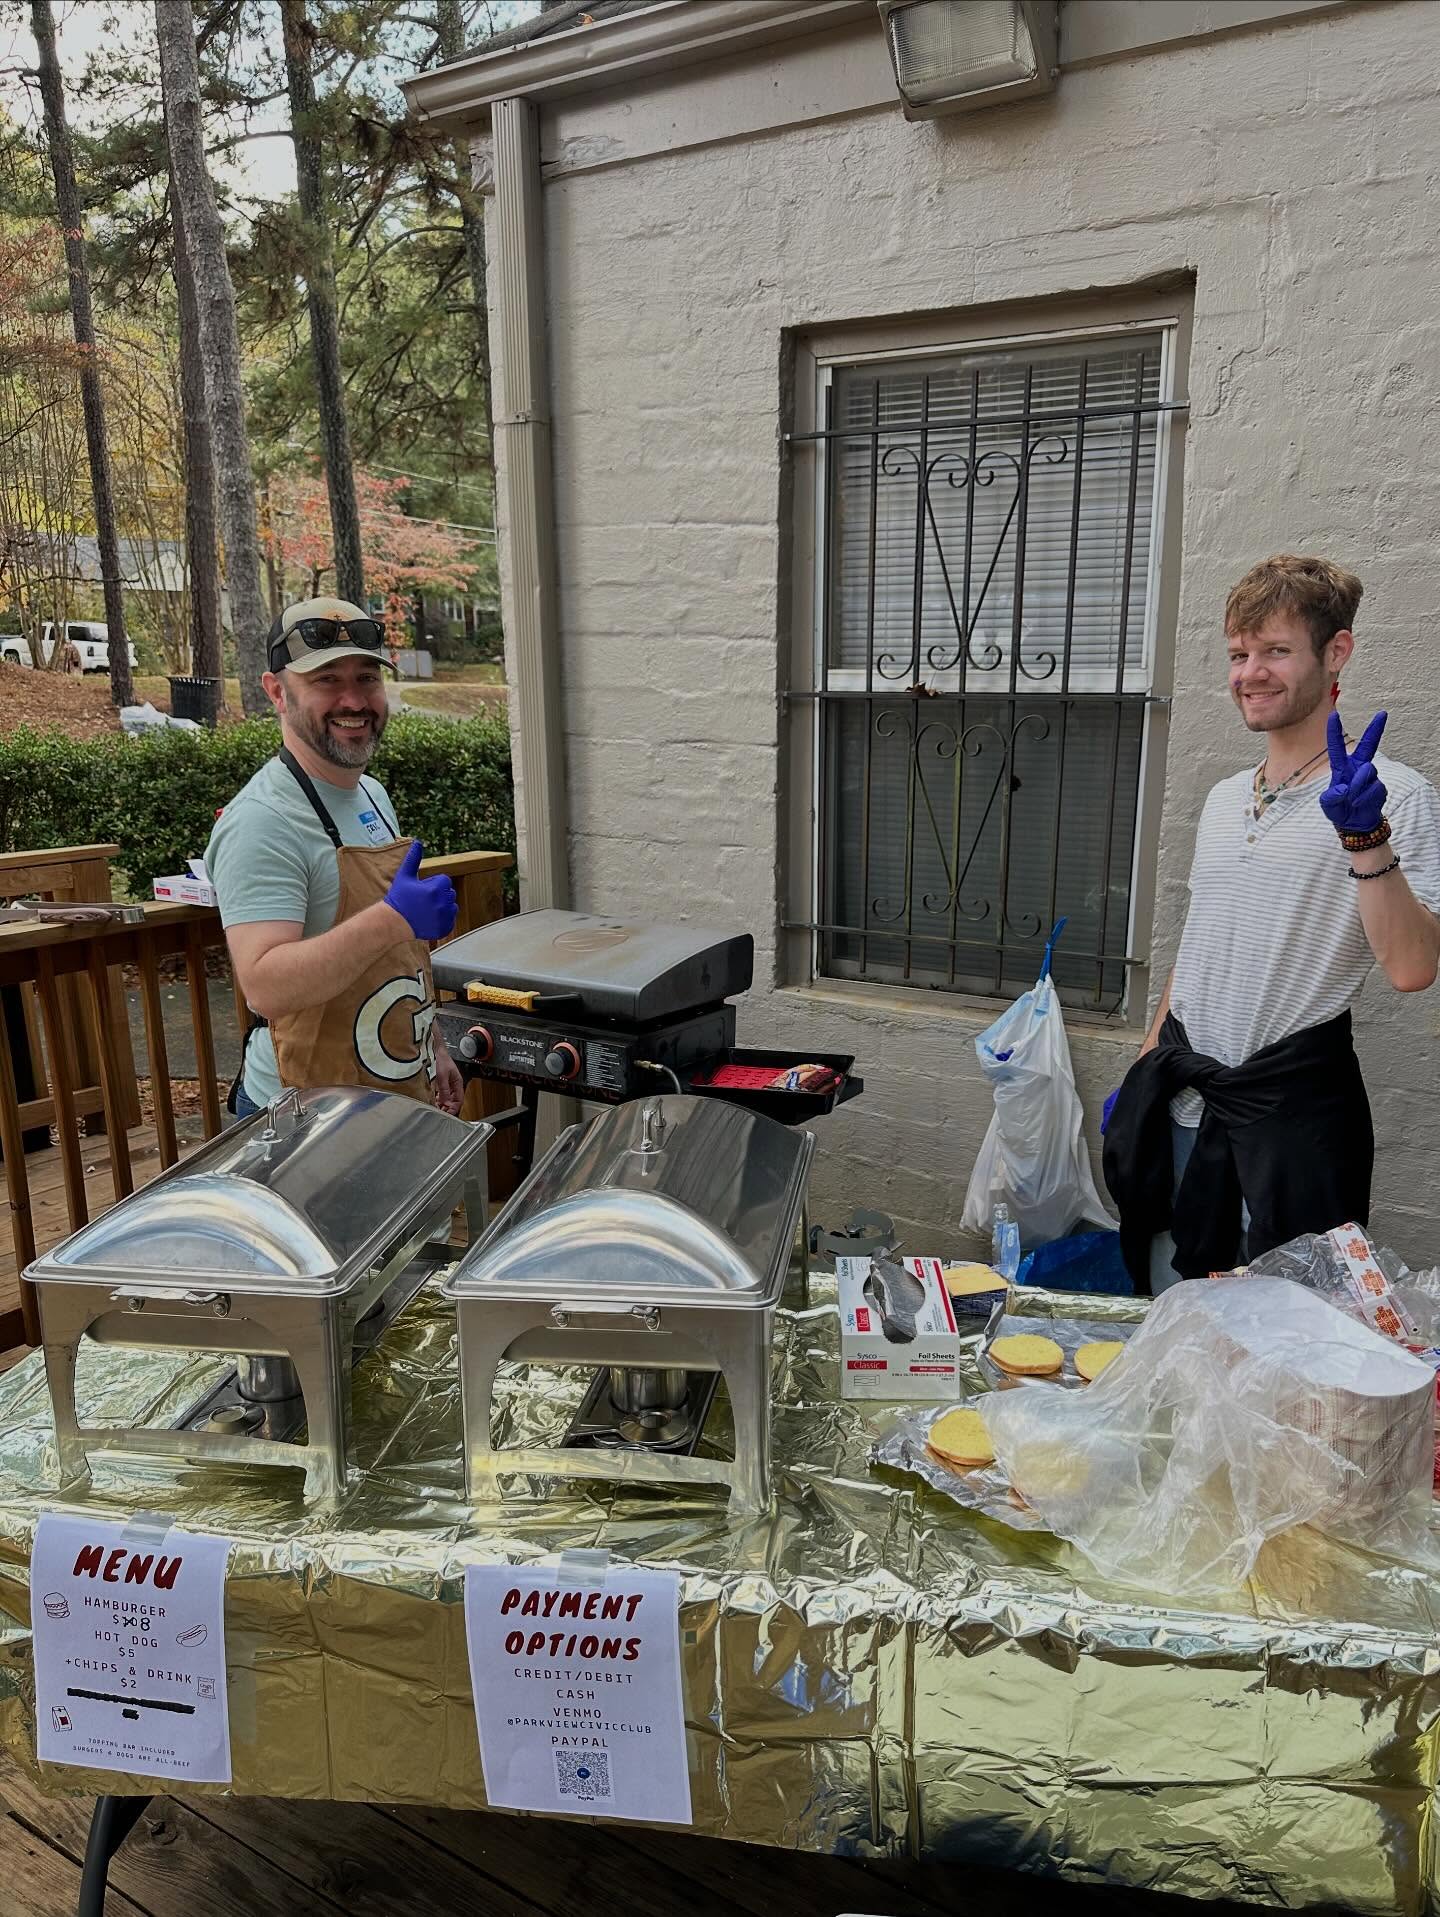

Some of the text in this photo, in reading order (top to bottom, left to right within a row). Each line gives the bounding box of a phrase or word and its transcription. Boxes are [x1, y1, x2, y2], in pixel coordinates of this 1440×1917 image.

[500, 1035, 544, 1049] BLACKSTONE
[857, 1352, 877, 1360] Sysco
[853, 1361, 881, 1369] Classic
[72, 1545, 183, 1590] MENU
[84, 1596, 167, 1618] HAMBURGER
[500, 1588, 643, 1622] PAYMENT
[95, 1630, 159, 1648] HOT DOG
[504, 1630, 642, 1661] OPTIONS
[118, 1647, 135, 1658] $5
[129, 1666, 136, 1675] &
[147, 1668, 192, 1684] DRINK
[514, 1668, 633, 1684] CREDIT/DEBIT
[120, 1677, 137, 1689] $2
[556, 1689, 595, 1700] CASH
[553, 1707, 602, 1718] VENMO
[507, 1717, 652, 1734] @PARKVIEWCIVICCLUB
[88, 1738, 175, 1756] TOPPING BAR INCLUDED
[551, 1736, 609, 1748] PAYPAL
[116, 1751, 134, 1759] DOGS
